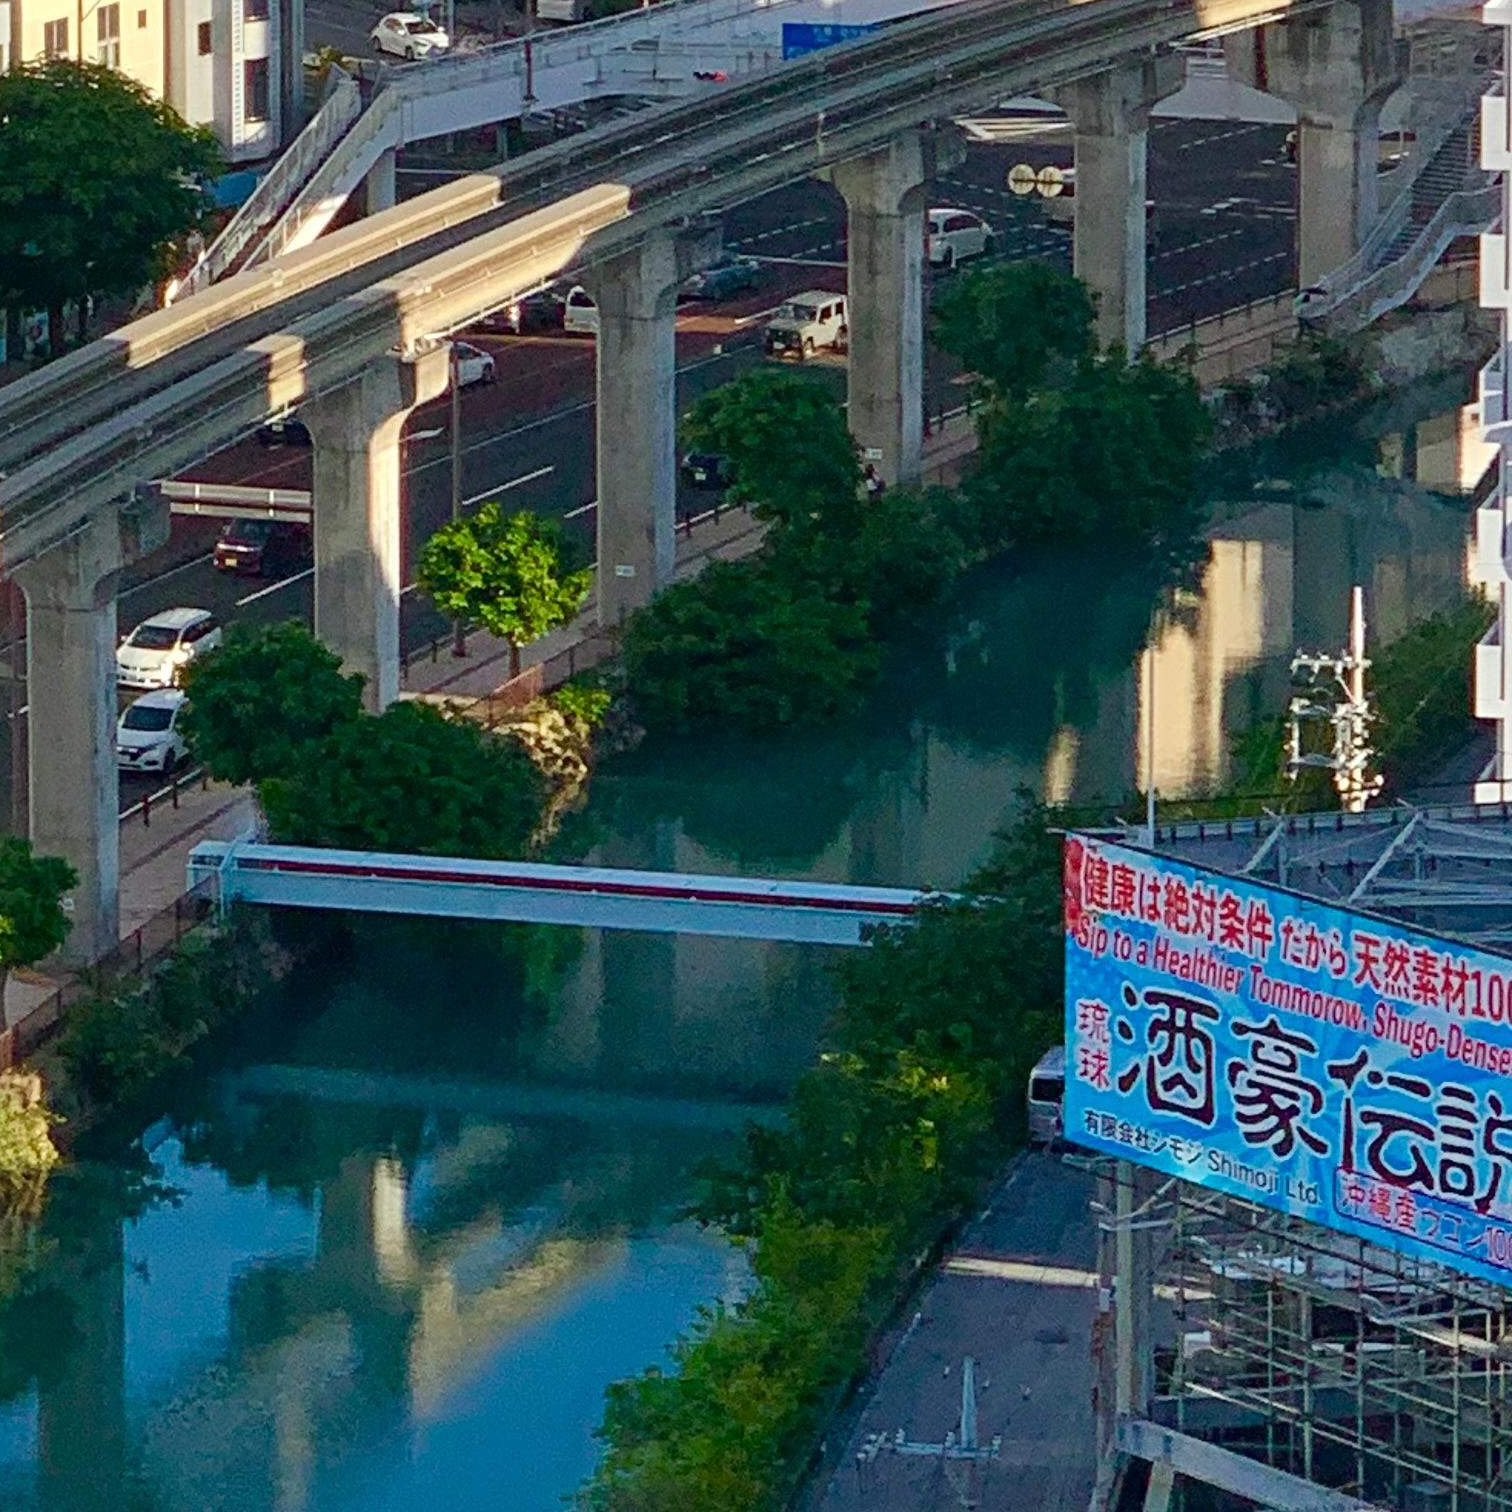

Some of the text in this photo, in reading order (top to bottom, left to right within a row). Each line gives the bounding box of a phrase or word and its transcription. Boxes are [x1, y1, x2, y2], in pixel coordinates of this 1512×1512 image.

[1078, 915, 1108, 954] Sip
[1114, 929, 1131, 960] to
[1136, 940, 1147, 965] a
[1153, 935, 1245, 994] Healthier
[1085, 855, 1272, 959] 健康は絶対条件
[1282, 919, 1346, 976] だから
[1079, 1001, 1111, 1089] 琉球
[1085, 1109, 1202, 1164] 有限会社シモジ
[1208, 1149, 1278, 1194] Shimoji
